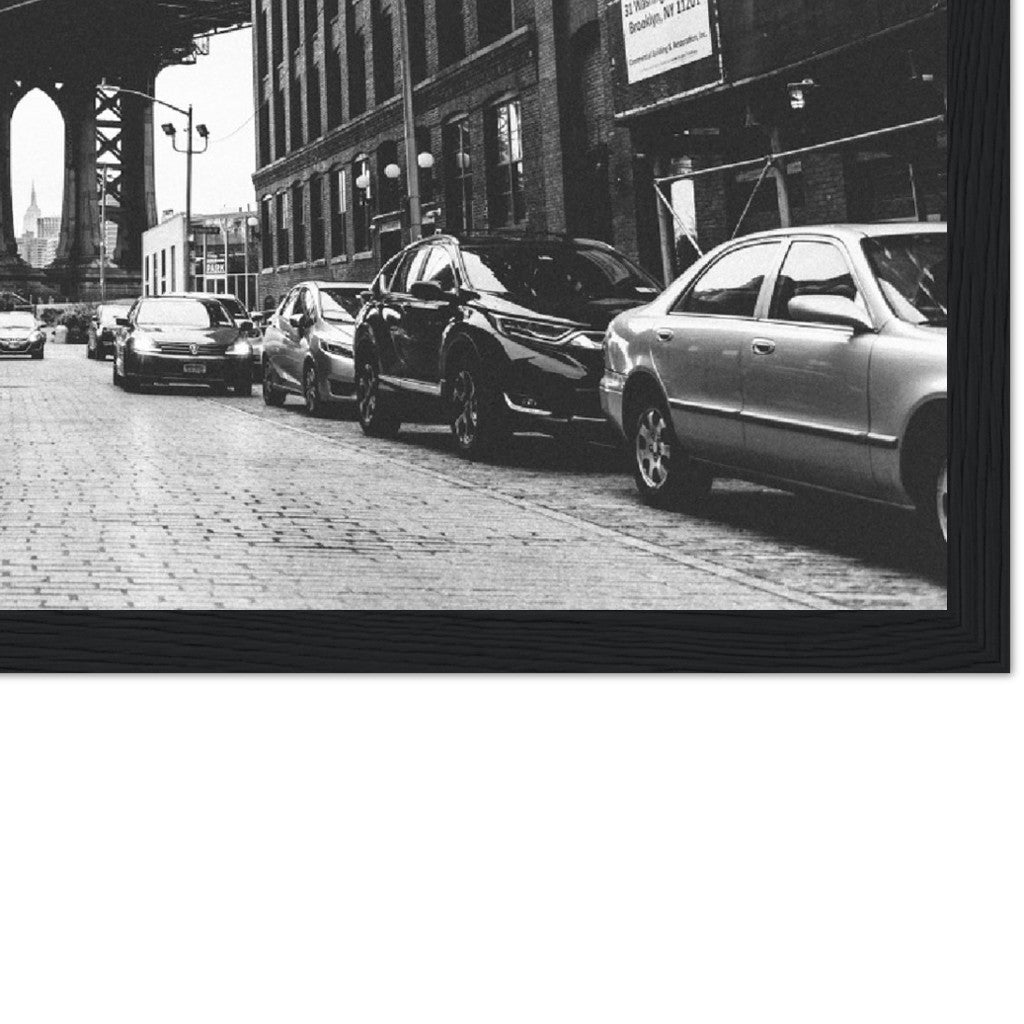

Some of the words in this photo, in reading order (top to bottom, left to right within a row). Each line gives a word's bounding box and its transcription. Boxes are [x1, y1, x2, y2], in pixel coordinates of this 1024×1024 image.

[624, 3, 633, 17] 31
[629, 11, 663, 34] Brooklyn,
[663, 3, 674, 20] NY
